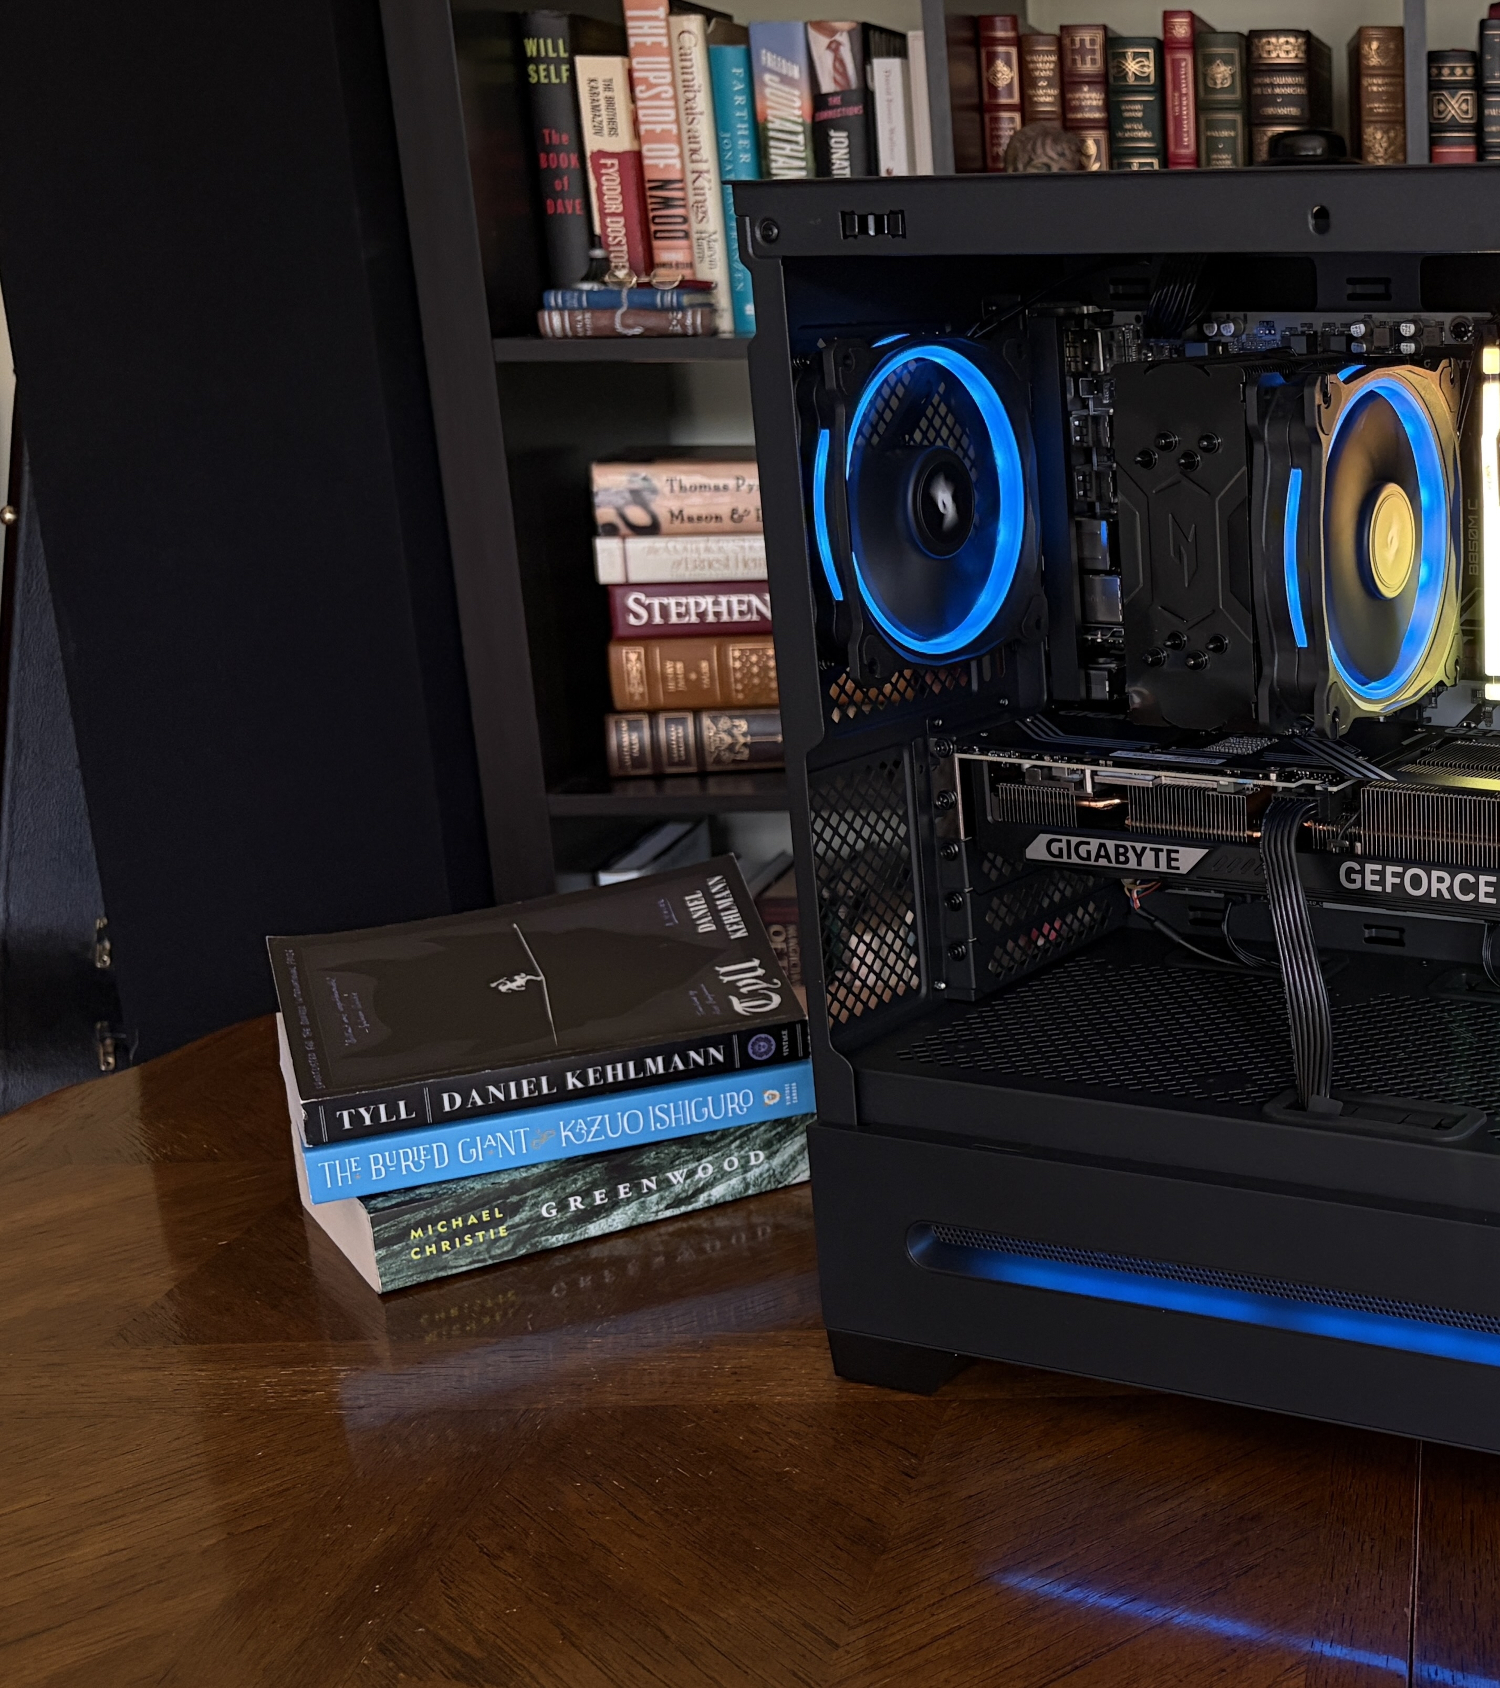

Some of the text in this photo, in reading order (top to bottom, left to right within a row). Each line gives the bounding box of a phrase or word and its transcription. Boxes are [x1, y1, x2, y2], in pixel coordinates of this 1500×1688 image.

[626, 7, 668, 47] THE
[524, 38, 569, 58] WILL
[761, 49, 800, 80] FREEDOM
[528, 63, 570, 84] SELF
[587, 77, 604, 137] KARAMAZOV
[603, 78, 619, 137] THE BROTHERS
[632, 57, 678, 135] UPSIDE
[677, 30, 712, 224] Cannibals and Kings
[731, 67, 751, 164] FARTHER
[763, 73, 807, 179] JONATHAN
[543, 129, 569, 145] The
[540, 153, 580, 169] BOOK
[641, 144, 681, 170] OF
[554, 176, 569, 191] of
[546, 199, 583, 215] DAVE
[599, 158, 630, 274] FYODOR DOSTOE
[665, 477, 729, 494] Thomas
[668, 509, 723, 525] Mason
[729, 508, 752, 524] &
[626, 591, 772, 627] STEPHEN
[1045, 836, 1181, 871] GIGABYTE
[1338, 860, 1498, 905] GEFORCE
[684, 889, 716, 934] DANIEL
[706, 875, 749, 940] KEHLMANN
[336, 1044, 727, 1131] TYLL DANIEL KEHLMANN
[318, 1088, 754, 1190] THE BURIED GIANT KAZUO ISHIGURO
[541, 1150, 767, 1219] GREENWOOD
[410, 1208, 505, 1240] MICHAEL
[410, 1225, 509, 1261] CHRISTIE
